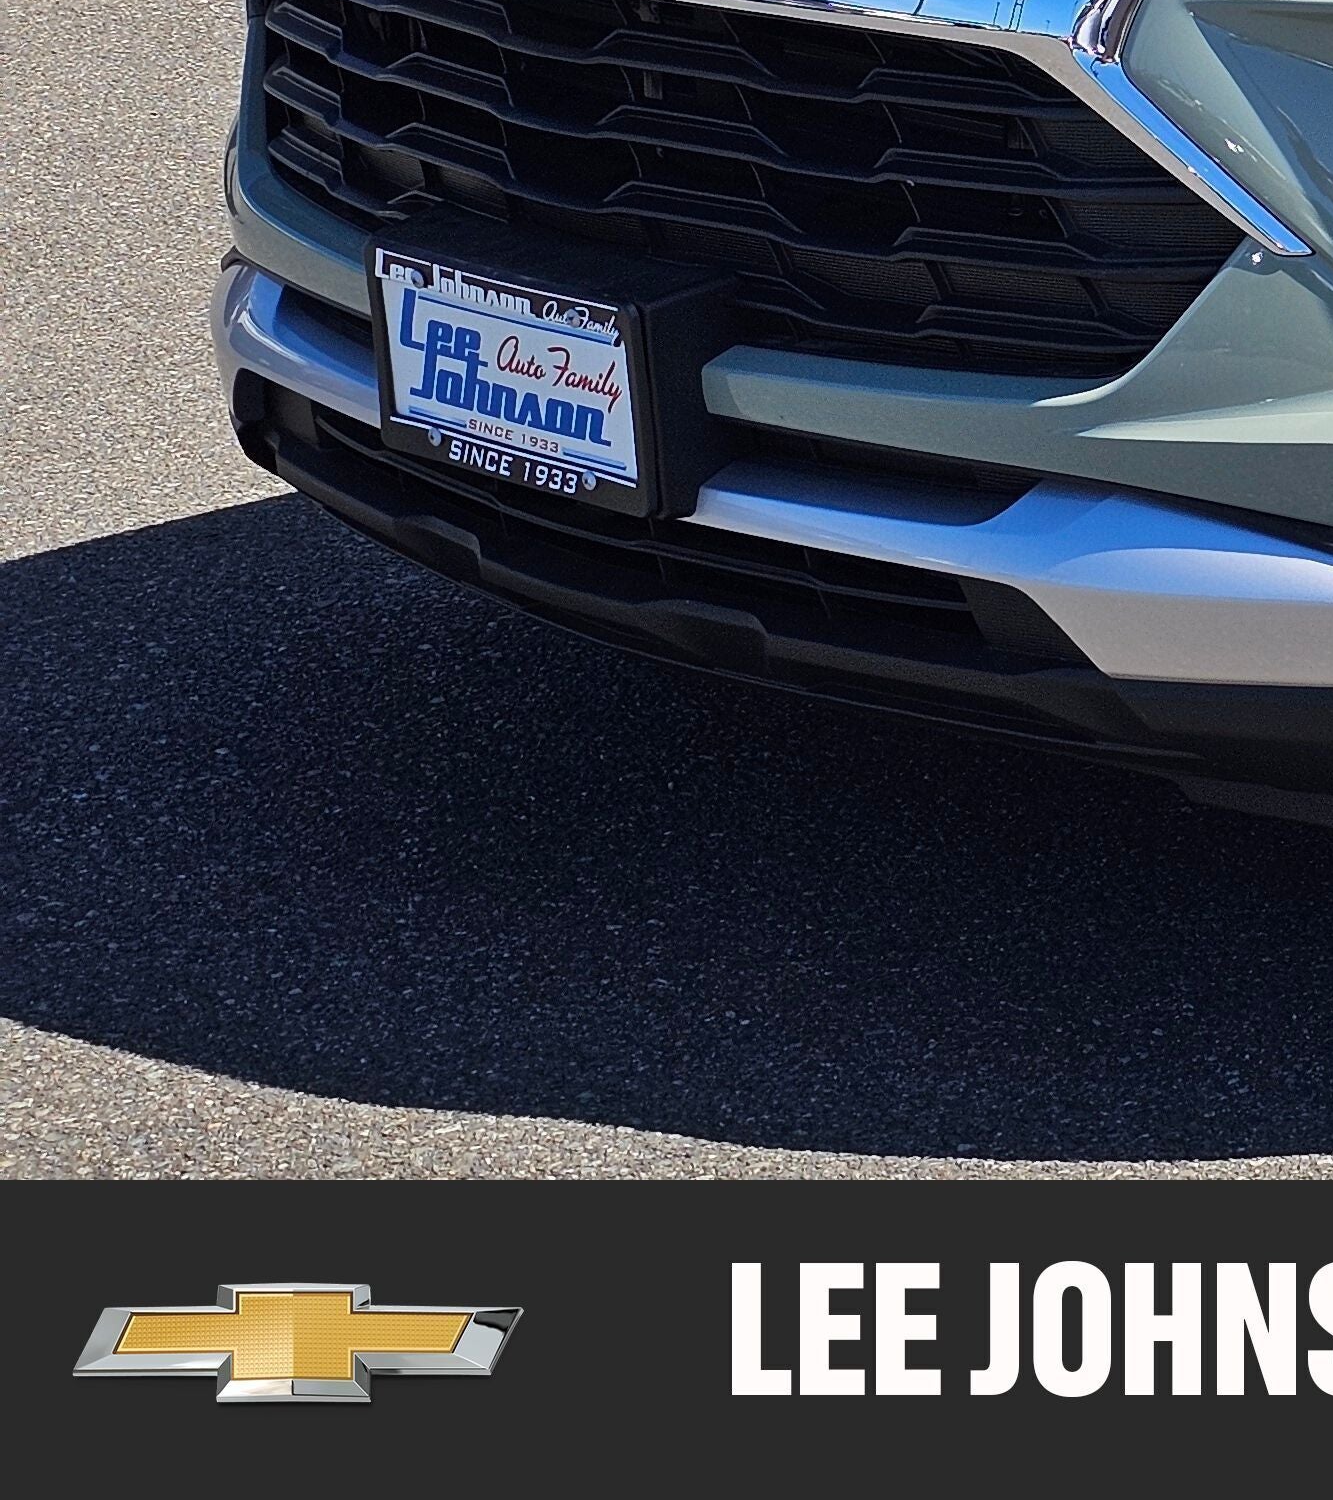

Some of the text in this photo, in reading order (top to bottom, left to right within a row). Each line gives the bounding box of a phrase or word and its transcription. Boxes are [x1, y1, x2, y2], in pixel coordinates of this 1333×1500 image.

[428, 263, 540, 319] Johnson
[542, 300, 576, 326] Aut
[400, 287, 623, 415] Lee Auto Family
[409, 348, 612, 448] Johnson
[468, 417, 560, 454] SINCE 1933
[448, 440, 578, 495] SINCE 1933
